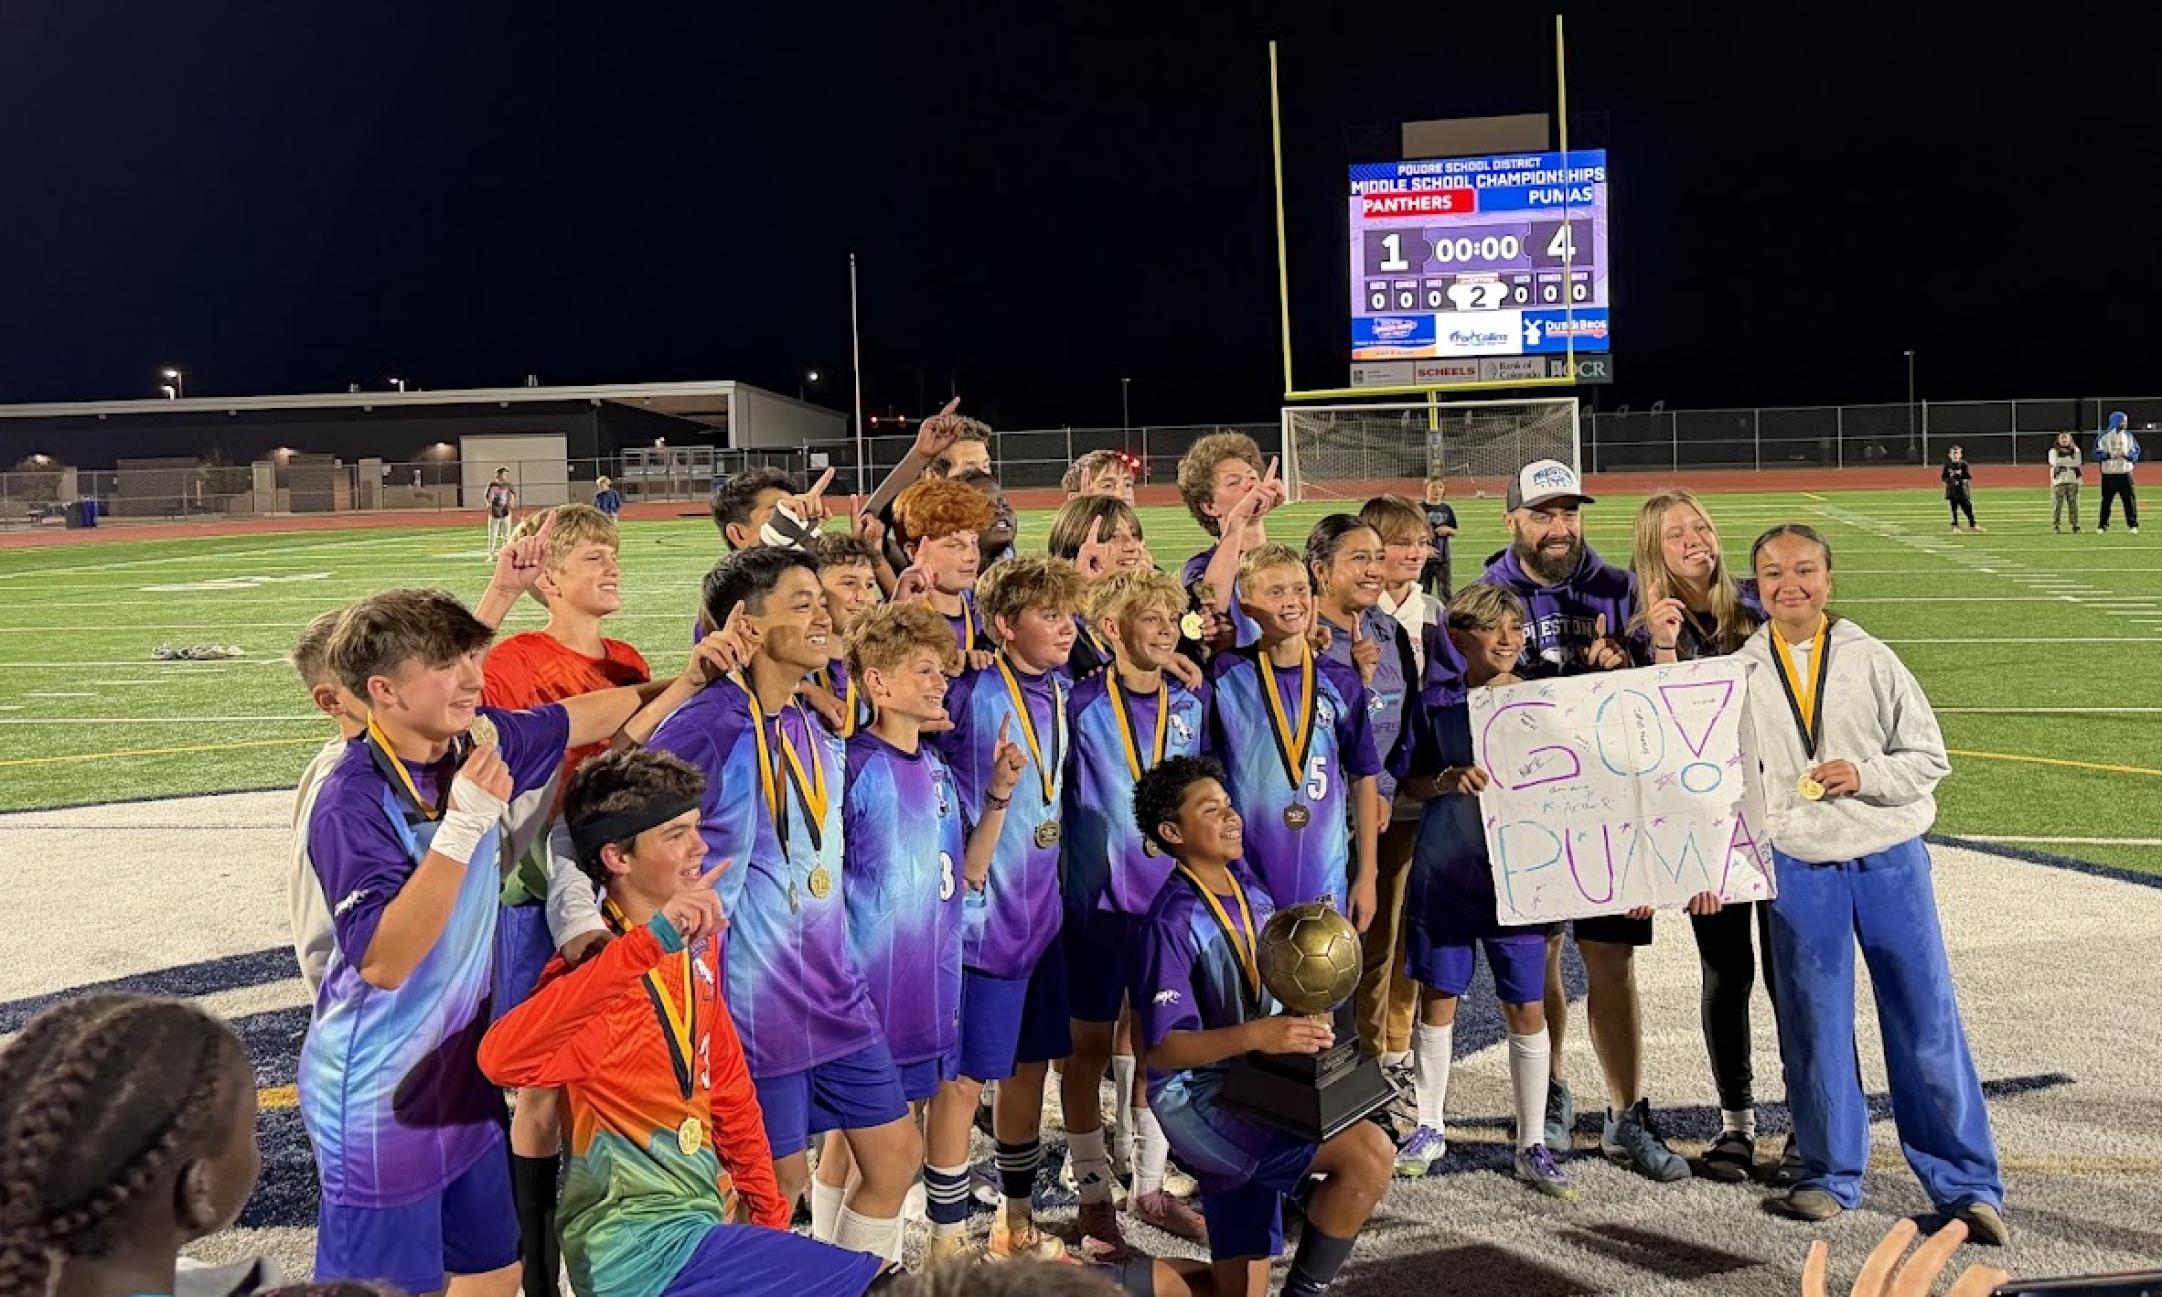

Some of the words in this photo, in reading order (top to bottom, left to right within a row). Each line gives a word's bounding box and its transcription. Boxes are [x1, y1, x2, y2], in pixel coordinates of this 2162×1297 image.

[1398, 163, 1444, 175] POUDRE
[1445, 161, 1491, 172] SCHOOL
[1492, 157, 1541, 169] DISTRICT
[1351, 178, 1407, 195] MIDDLE
[1411, 175, 1473, 190] SCHOOL
[1476, 167, 1605, 188] CHAMPIONSHIPS
[1363, 195, 1453, 213] PANTHERS
[1528, 186, 1592, 205] PUMAS
[1380, 233, 1409, 271] 1
[1436, 235, 1519, 262] 00:00
[1547, 224, 1576, 262] 4
[1371, 292, 1386, 310] 0
[1399, 291, 1413, 308] 0
[1428, 290, 1442, 307] 0
[1470, 286, 1487, 308] 2
[1514, 286, 1528, 303] 0
[1543, 284, 1558, 303] 0
[1572, 283, 1587, 302] 0
[1417, 367, 1476, 377] SCHEELS
[1499, 361, 1521, 369] Bank
[1523, 359, 1533, 368] of
[1306, 755, 1329, 801] 5
[1499, 811, 1777, 918] PUMA
